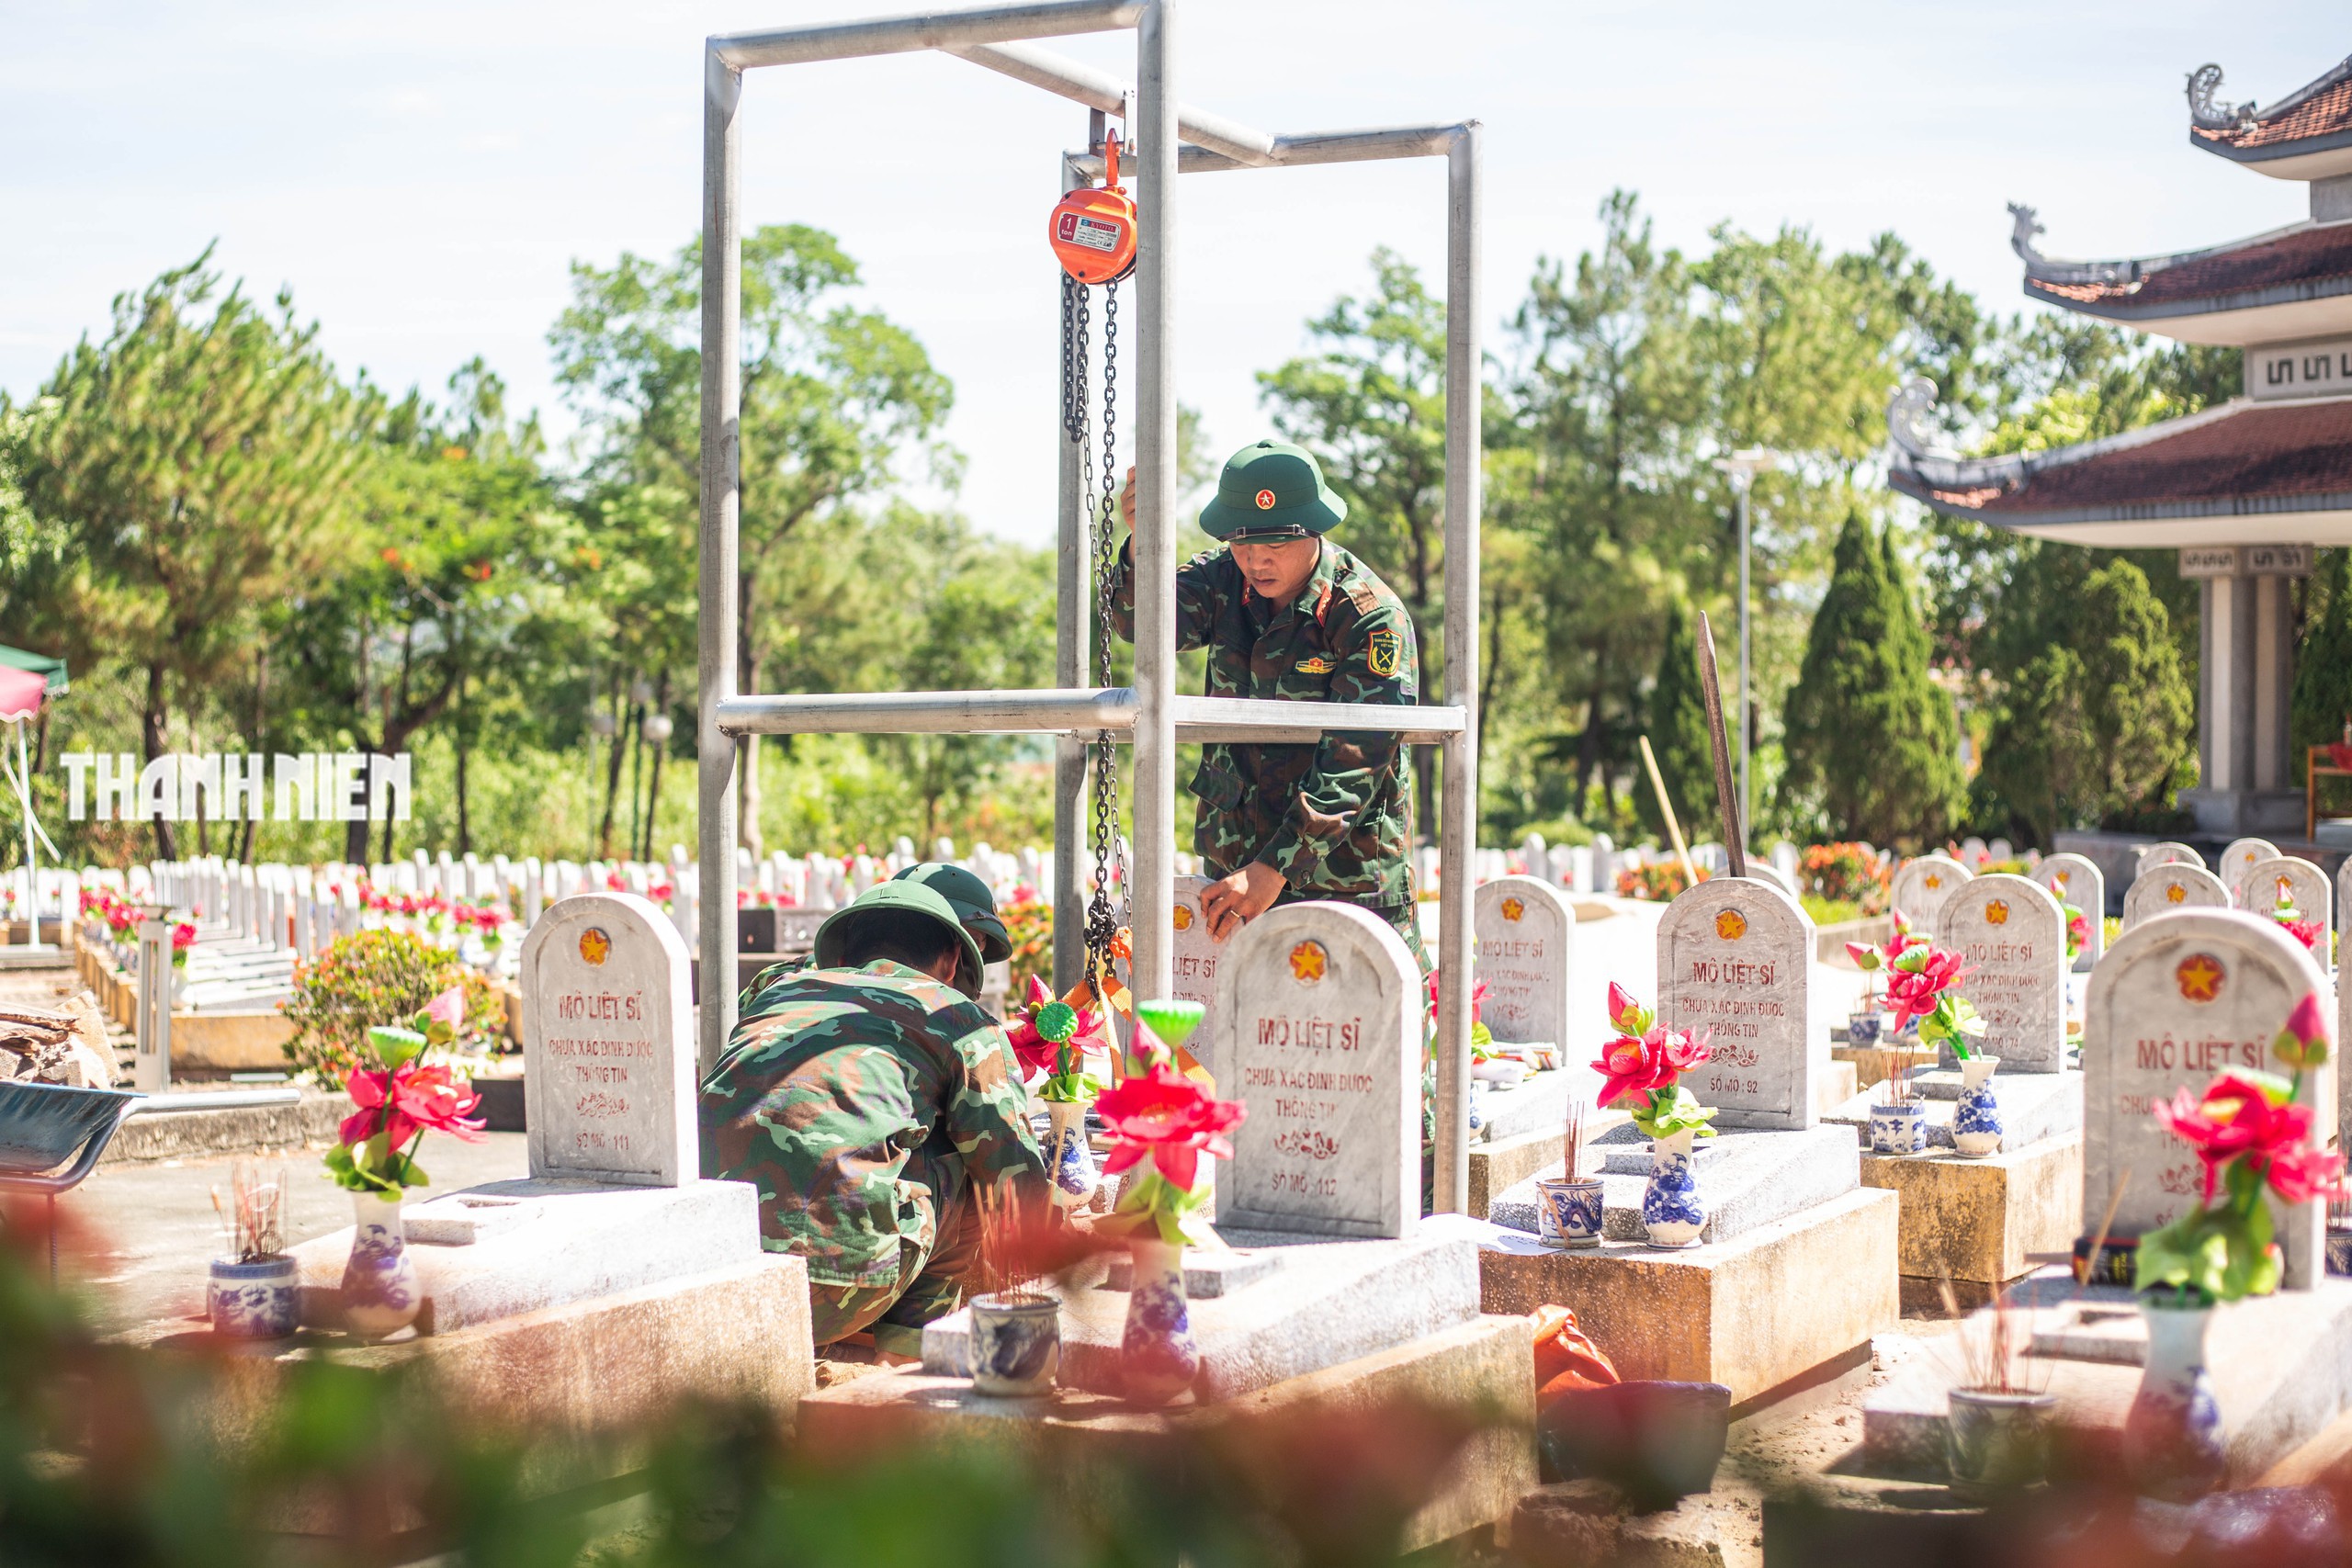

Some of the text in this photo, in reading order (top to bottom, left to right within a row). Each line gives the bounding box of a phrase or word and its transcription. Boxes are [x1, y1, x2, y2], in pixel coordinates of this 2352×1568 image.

[1067, 217, 1072, 230] 1
[1091, 220, 1114, 231] KYOTO
[1743, 1023, 1758, 1038] TIN
[611, 1066, 628, 1083] TIN
[1747, 1080, 1758, 1093] 92
[614, 1134, 629, 1150] 111
